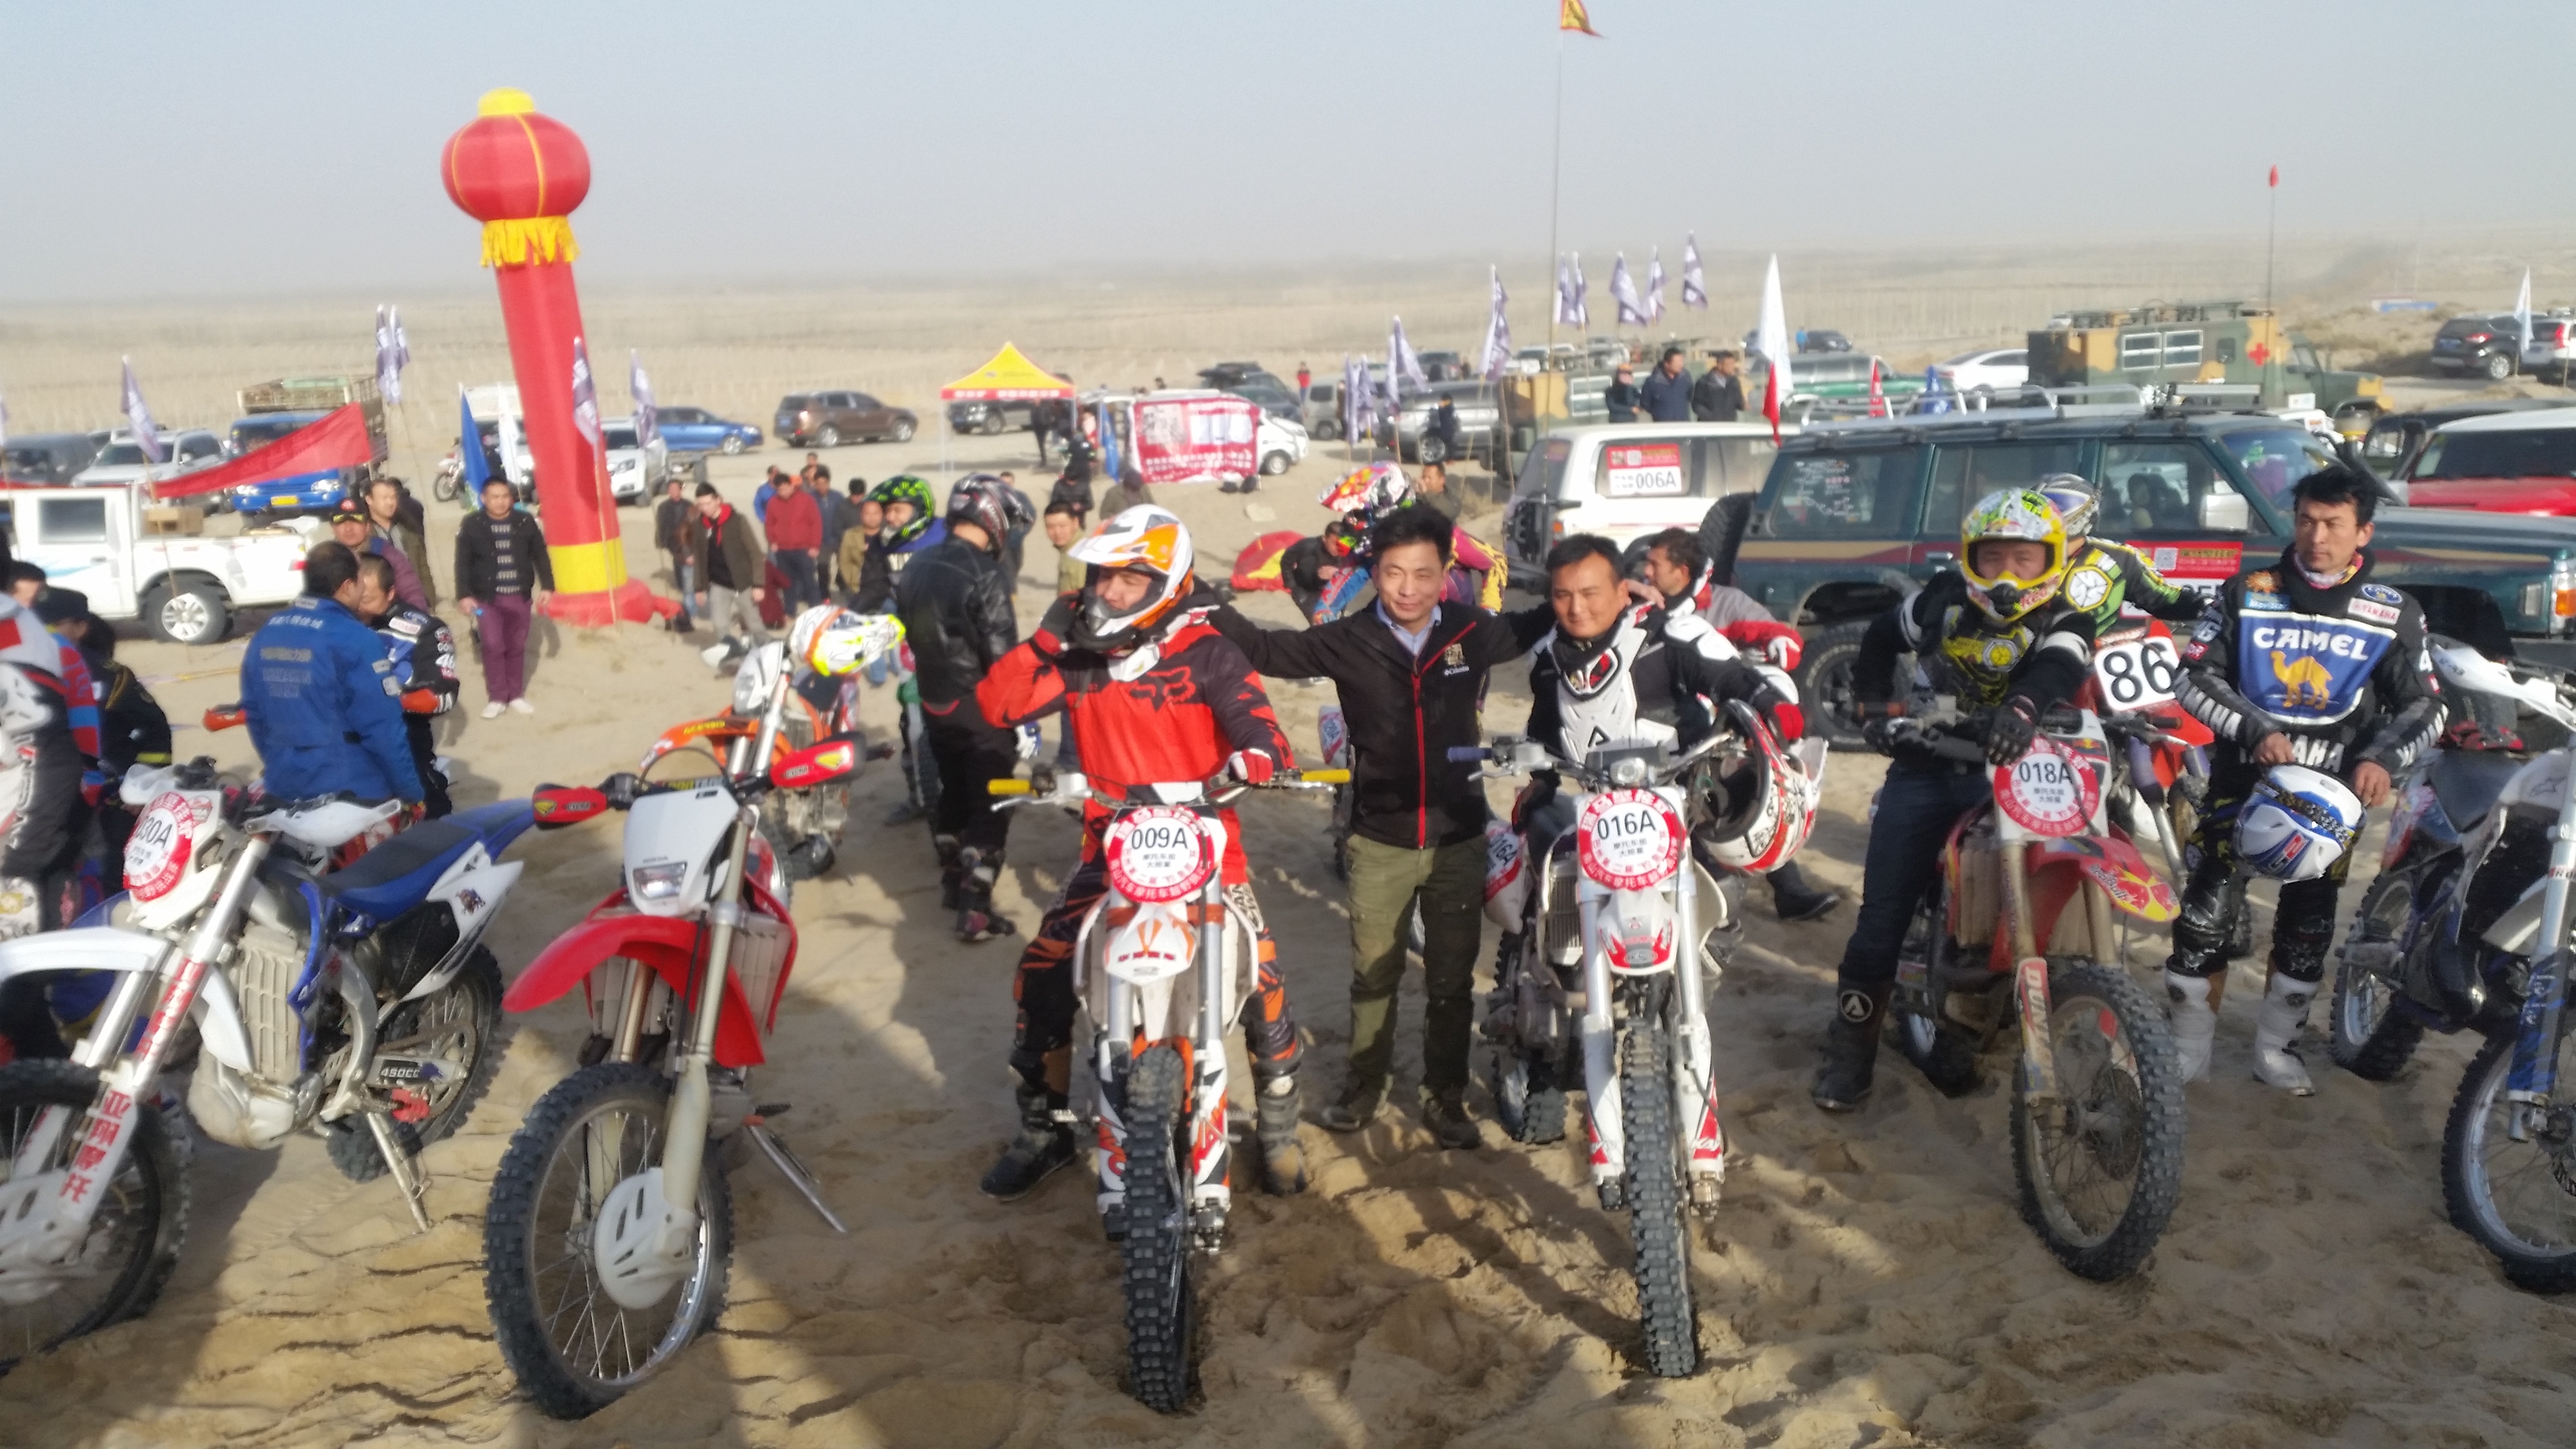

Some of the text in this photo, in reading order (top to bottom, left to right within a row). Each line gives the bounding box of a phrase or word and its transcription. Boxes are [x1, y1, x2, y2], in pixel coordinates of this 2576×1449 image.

[1636, 471, 1677, 489] 006A
[2253, 627, 2368, 661] CAMEL
[2103, 642, 2176, 703] 86
[2019, 761, 2073, 784] 018A
[1597, 810, 1656, 839] 016A
[1131, 827, 1188, 850] 009A
